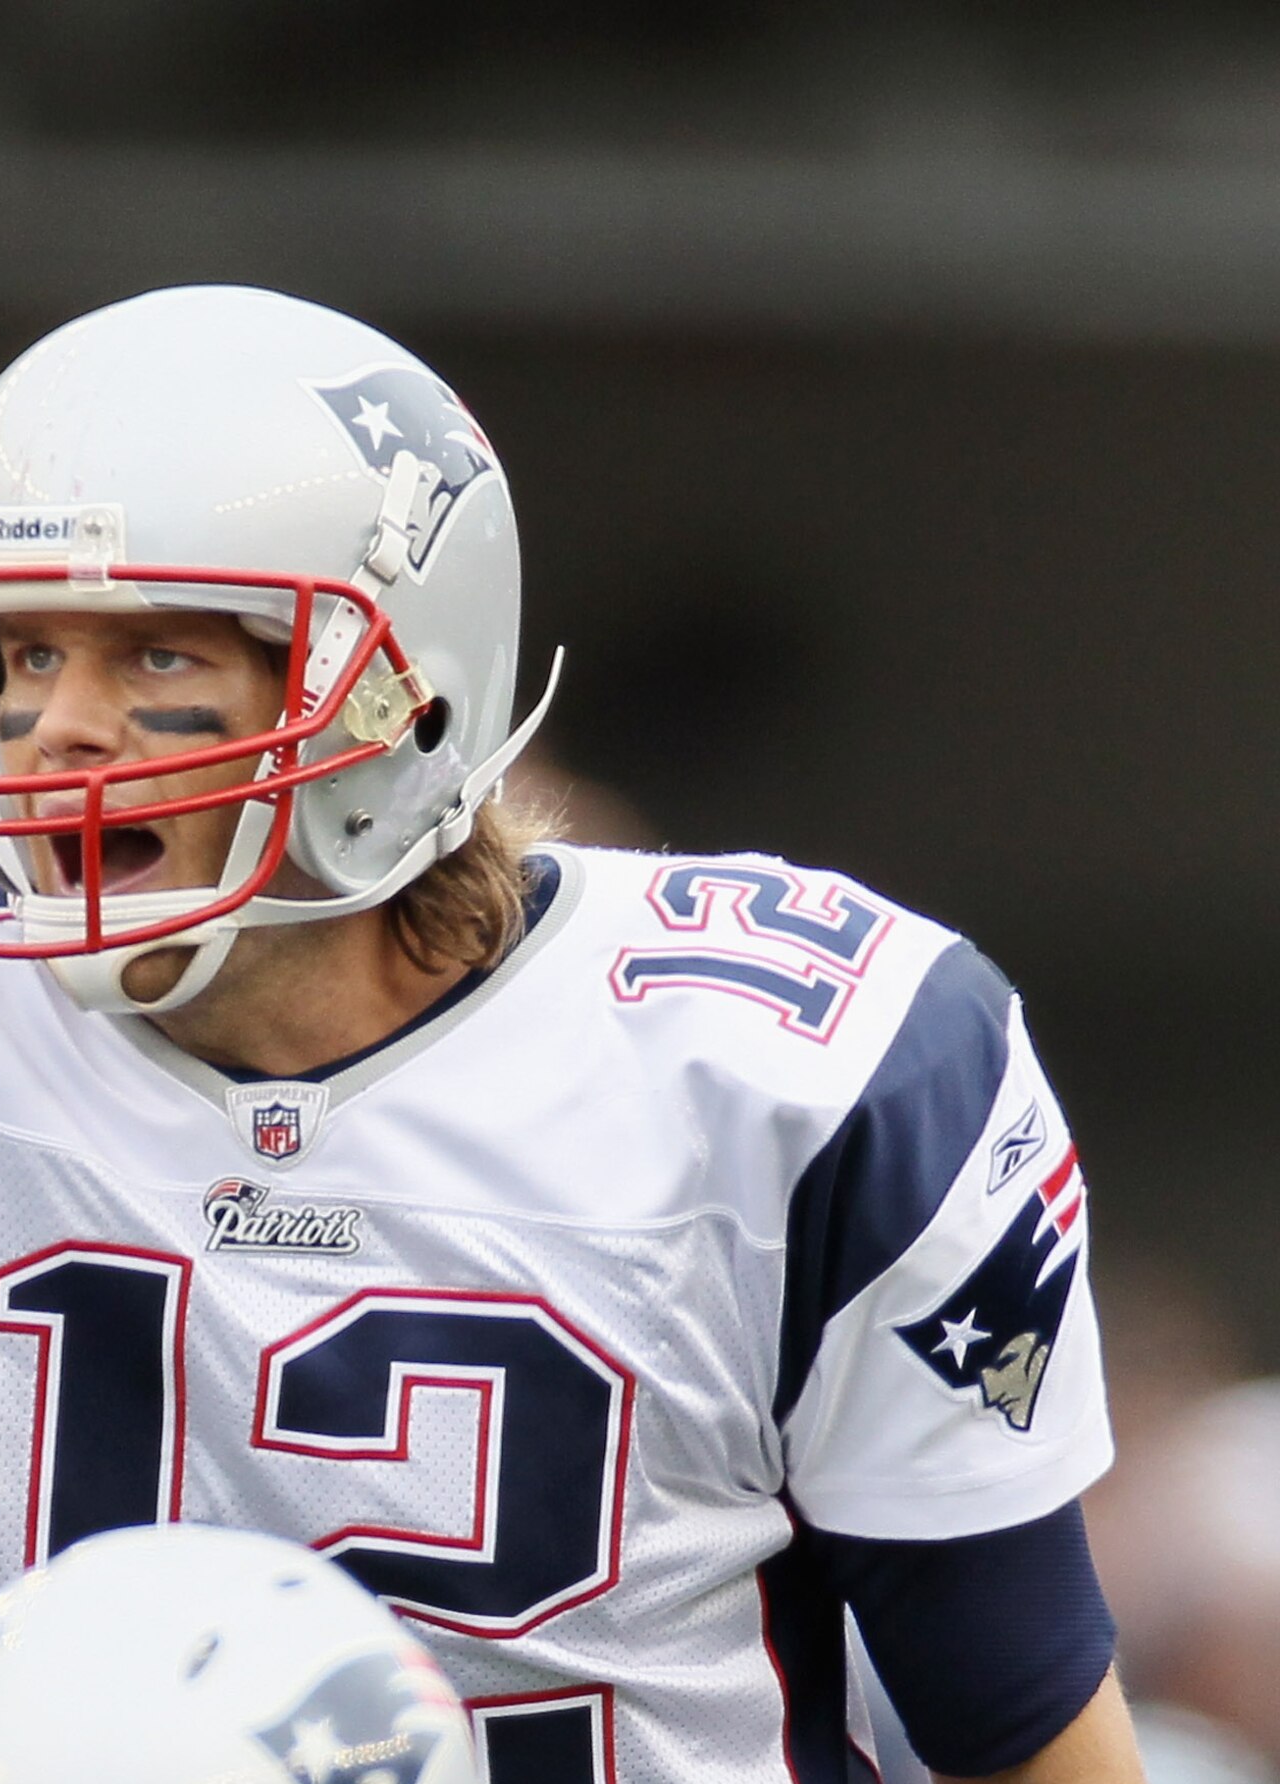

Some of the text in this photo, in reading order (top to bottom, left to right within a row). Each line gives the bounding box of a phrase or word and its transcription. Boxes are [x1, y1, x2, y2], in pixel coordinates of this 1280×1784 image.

[609, 861, 896, 1046] 12
[235, 1087, 318, 1106] EQUIPMENT
[257, 1126, 298, 1153] NFL
[206, 1199, 361, 1255] Patriots
